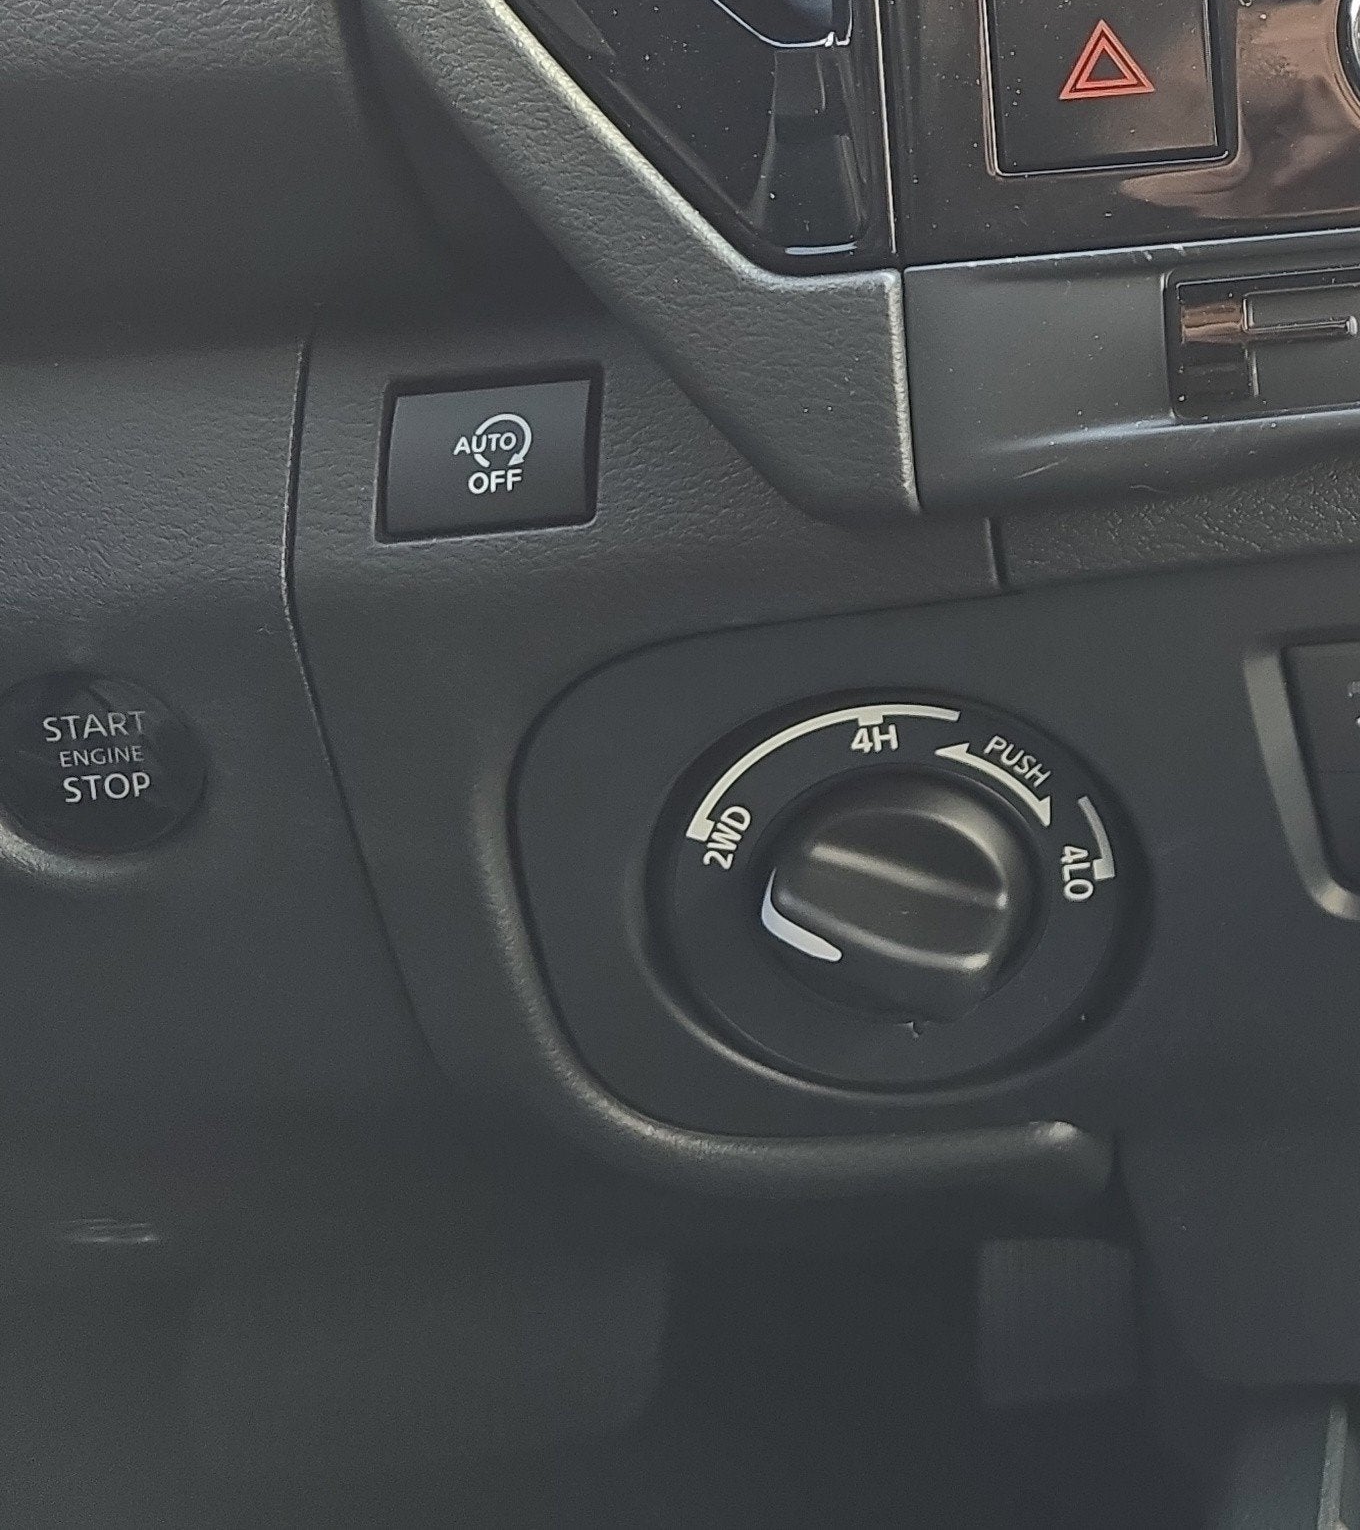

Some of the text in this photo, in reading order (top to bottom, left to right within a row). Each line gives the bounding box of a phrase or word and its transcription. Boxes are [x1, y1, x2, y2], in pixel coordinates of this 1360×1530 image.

[453, 431, 517, 456] AUTO
[468, 468, 523, 494] OFF
[43, 710, 146, 743] START
[850, 725, 898, 755] 4H
[60, 745, 144, 768] ENGINE
[984, 735, 1051, 788] PUSH
[63, 771, 151, 803] STOP
[703, 805, 752, 870] 2WD
[1063, 844, 1094, 901] 4LO
